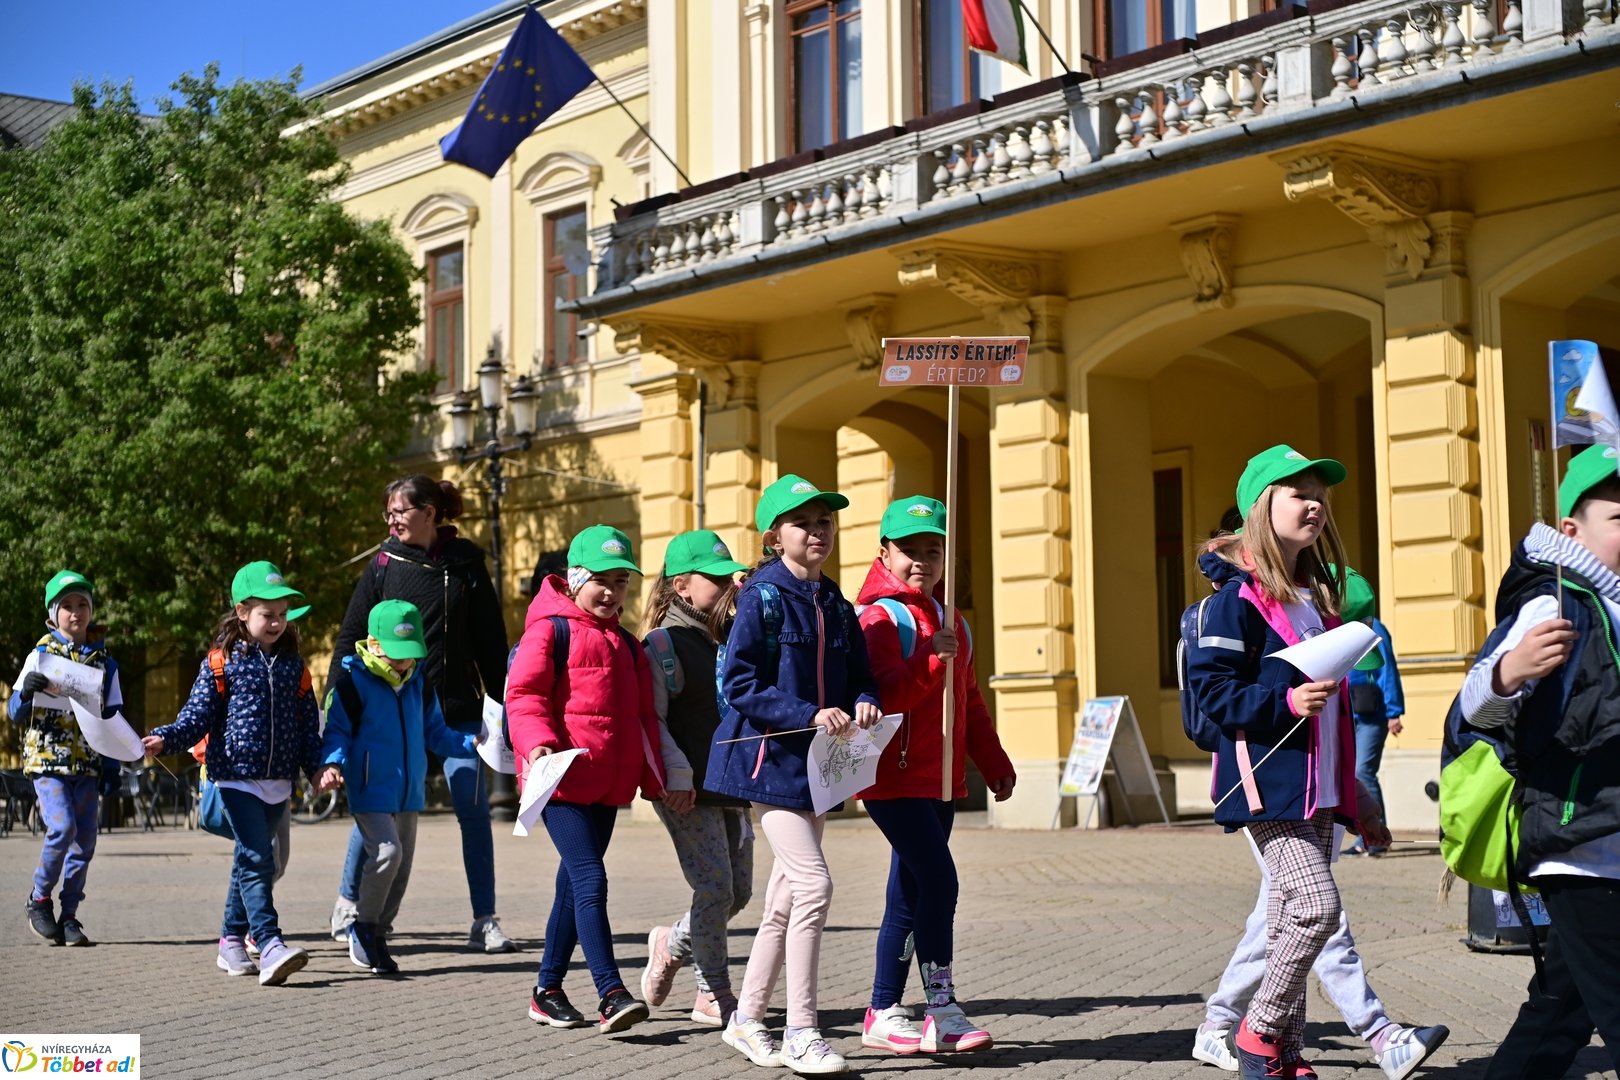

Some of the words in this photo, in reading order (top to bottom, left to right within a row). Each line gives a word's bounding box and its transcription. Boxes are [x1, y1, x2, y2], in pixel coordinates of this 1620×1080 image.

[896, 341, 960, 361] LASSÍTS
[964, 341, 1017, 361] ÉRTEM!
[927, 363, 986, 382] ÉRTED?
